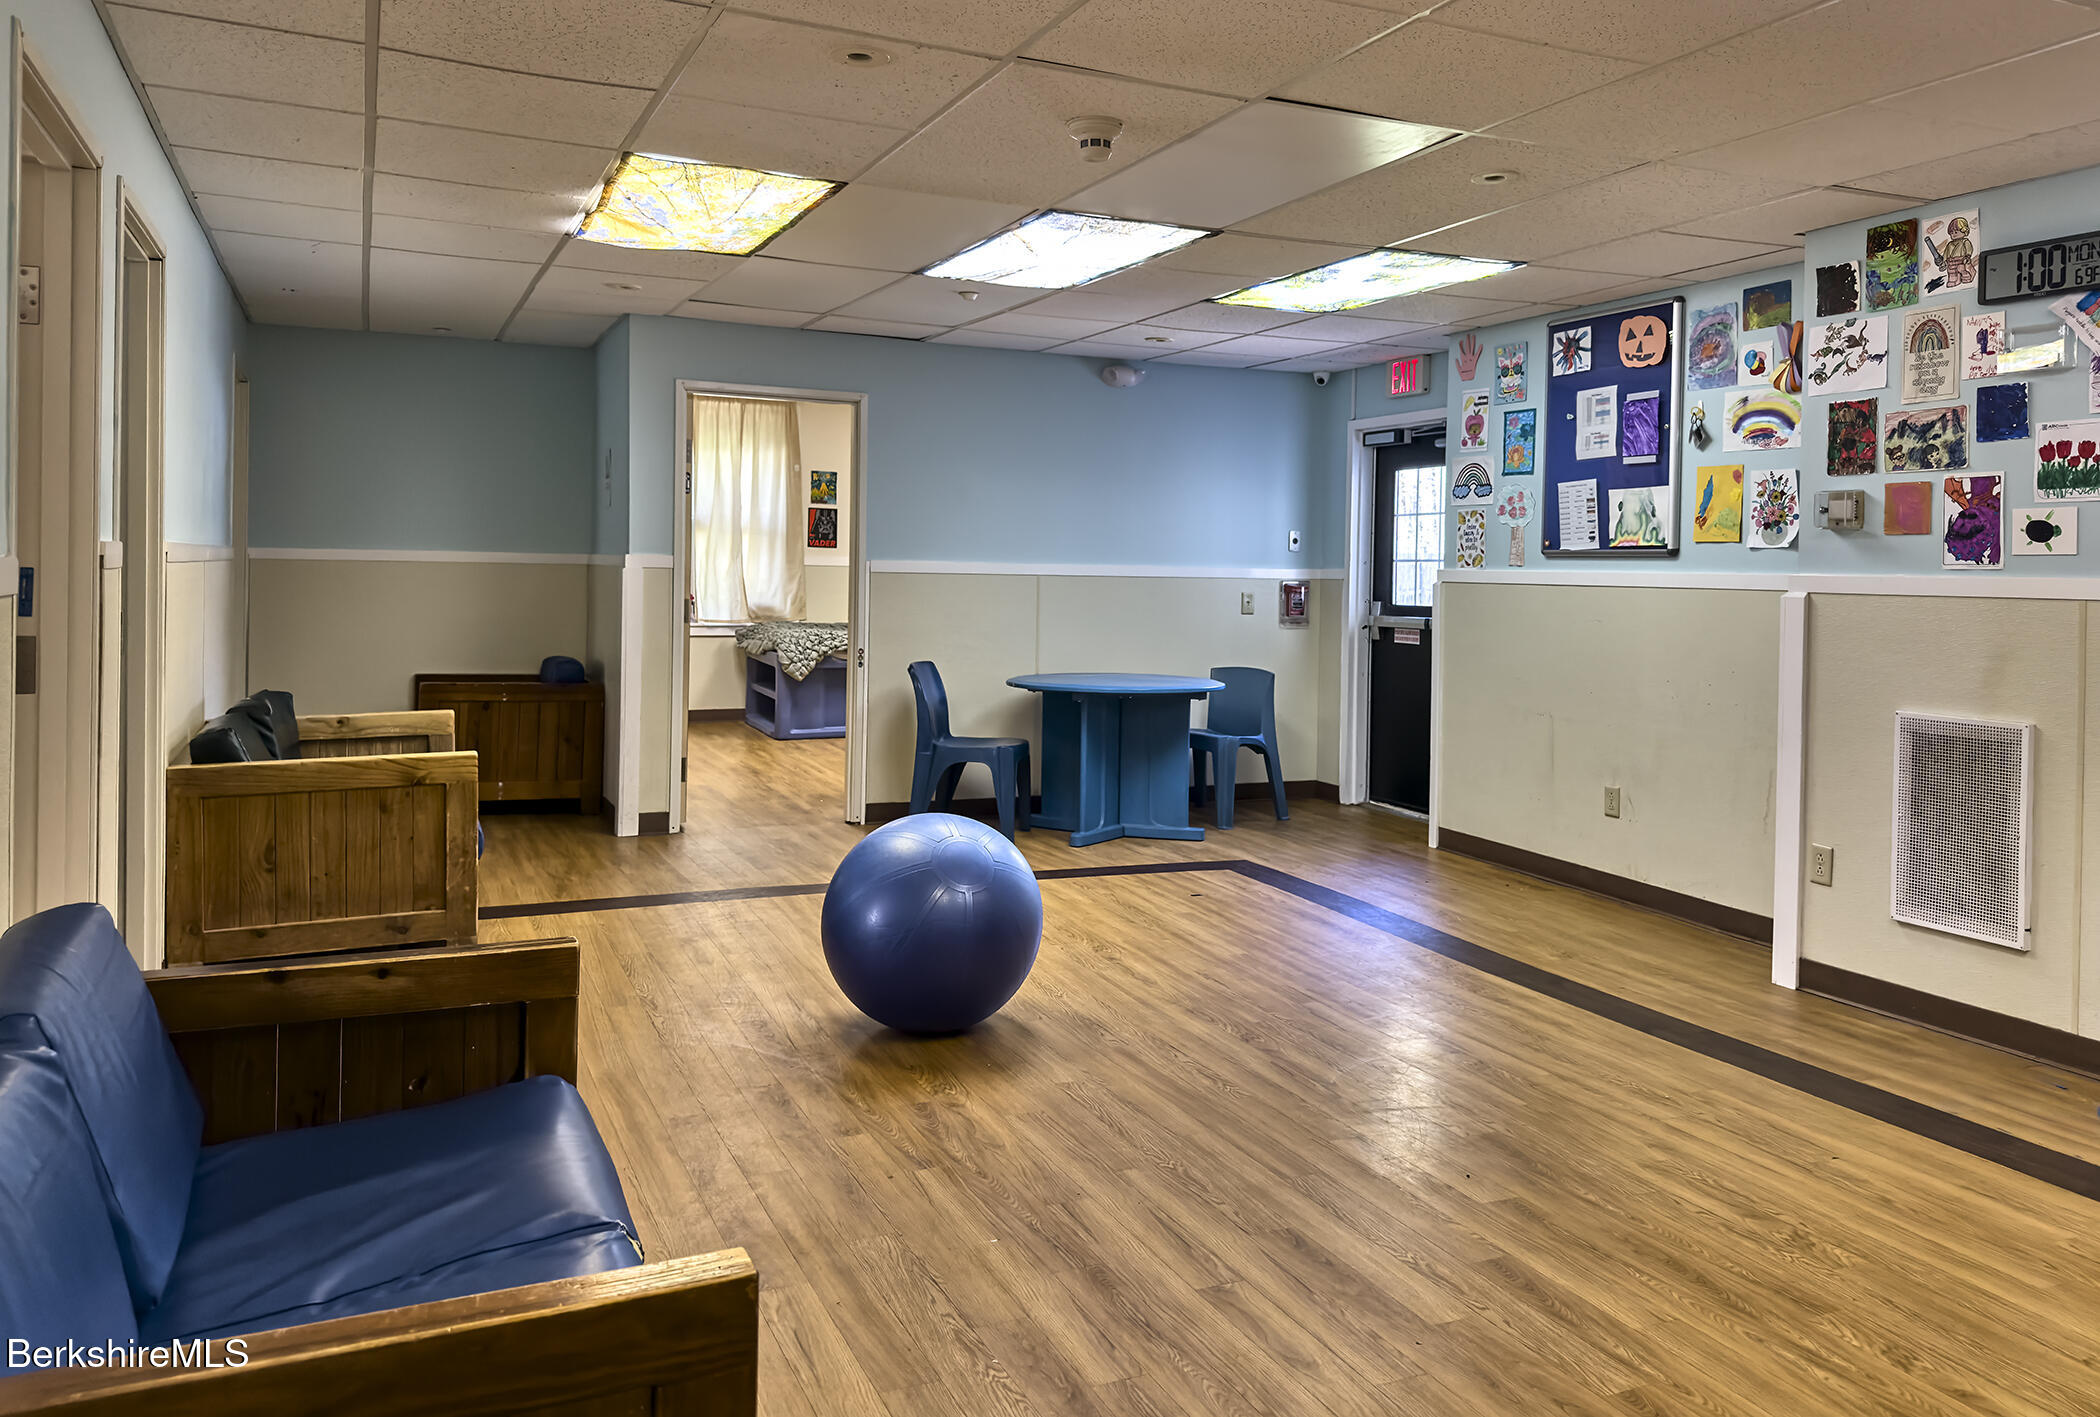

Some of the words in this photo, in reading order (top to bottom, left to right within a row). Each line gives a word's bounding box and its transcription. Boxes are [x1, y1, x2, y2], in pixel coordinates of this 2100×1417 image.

[2068, 242, 2100, 263] MON
[2016, 244, 2067, 294] 1:00
[2075, 265, 2100, 285] 69F
[1391, 358, 1419, 394] EXIT
[808, 539, 836, 547] VADER
